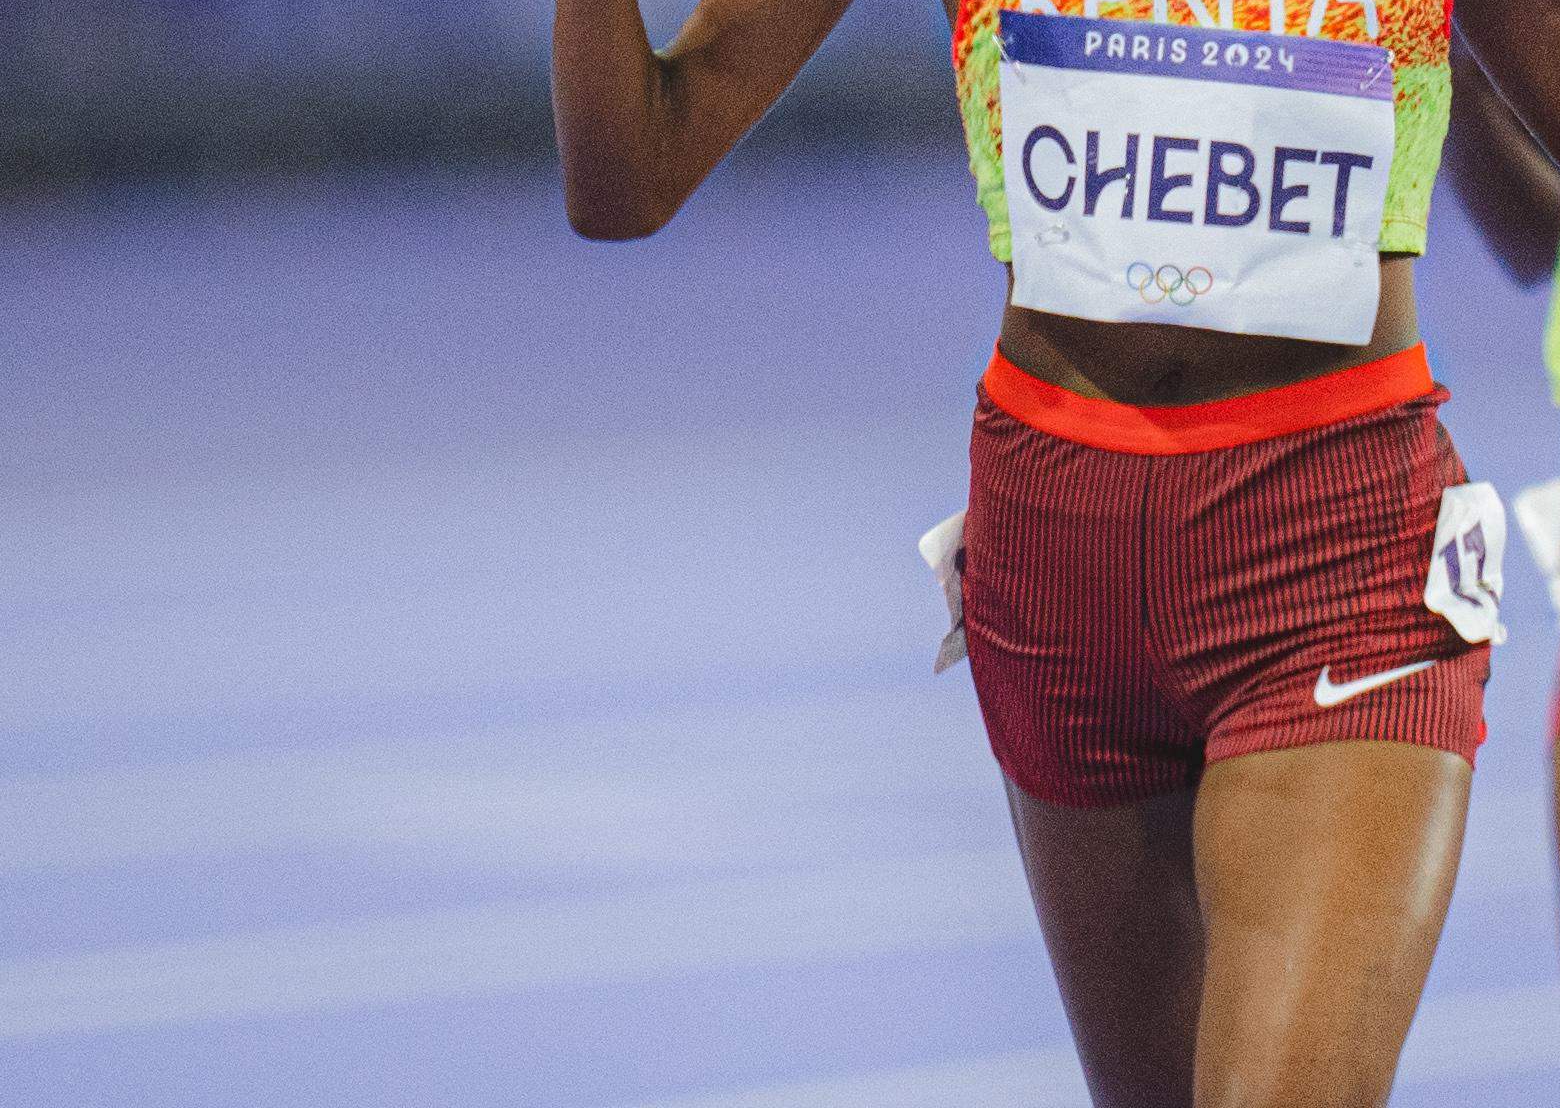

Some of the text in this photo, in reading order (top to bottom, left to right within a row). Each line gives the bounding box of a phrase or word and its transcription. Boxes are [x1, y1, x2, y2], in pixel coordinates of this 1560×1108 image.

[1084, 30, 1296, 73] PARIS 2024
[1021, 124, 1375, 238] CHEBET
